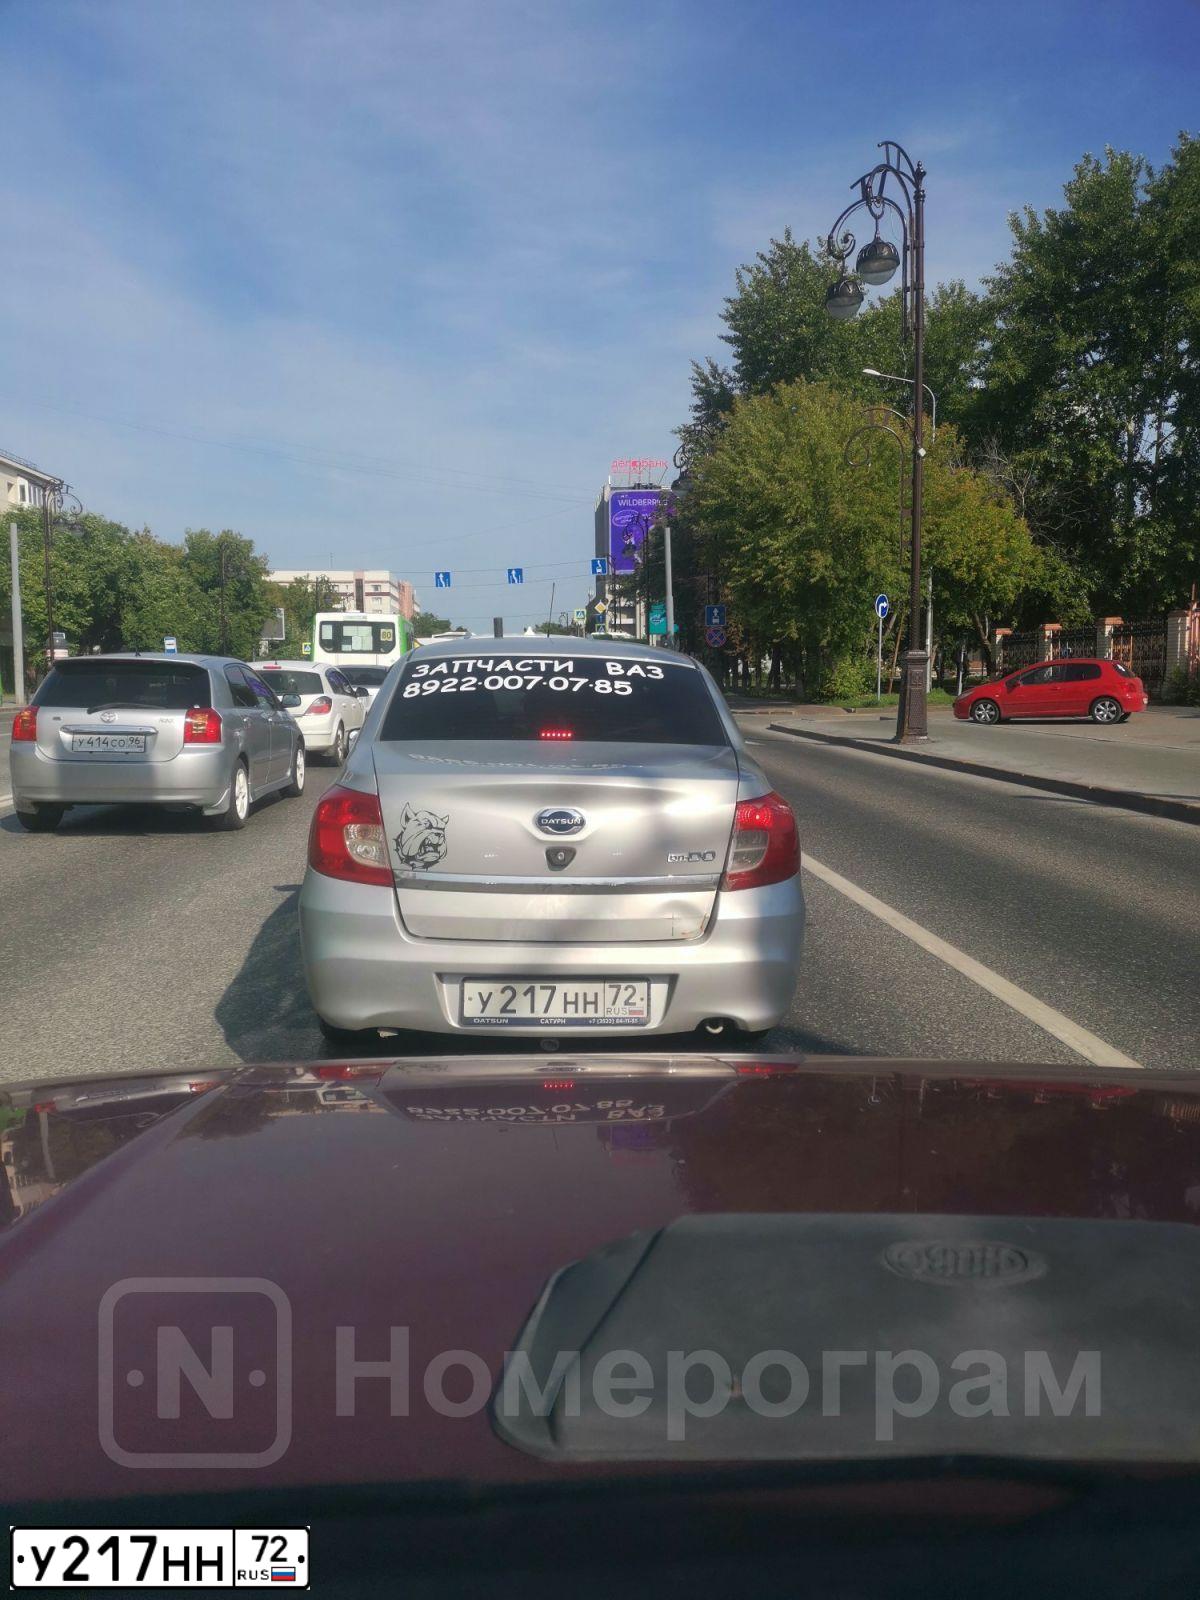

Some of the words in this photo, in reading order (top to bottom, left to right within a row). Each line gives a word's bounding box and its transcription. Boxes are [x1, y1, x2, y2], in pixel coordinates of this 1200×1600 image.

[382, 631, 391, 639] 80
[412, 660, 573, 677] ЗАПЧАСТИ
[606, 662, 664, 679] ВАЗ
[129, 736, 140, 744] 96
[478, 985, 599, 1014] У217НН
[608, 984, 637, 1006] 72
[606, 1007, 628, 1016] RUS
